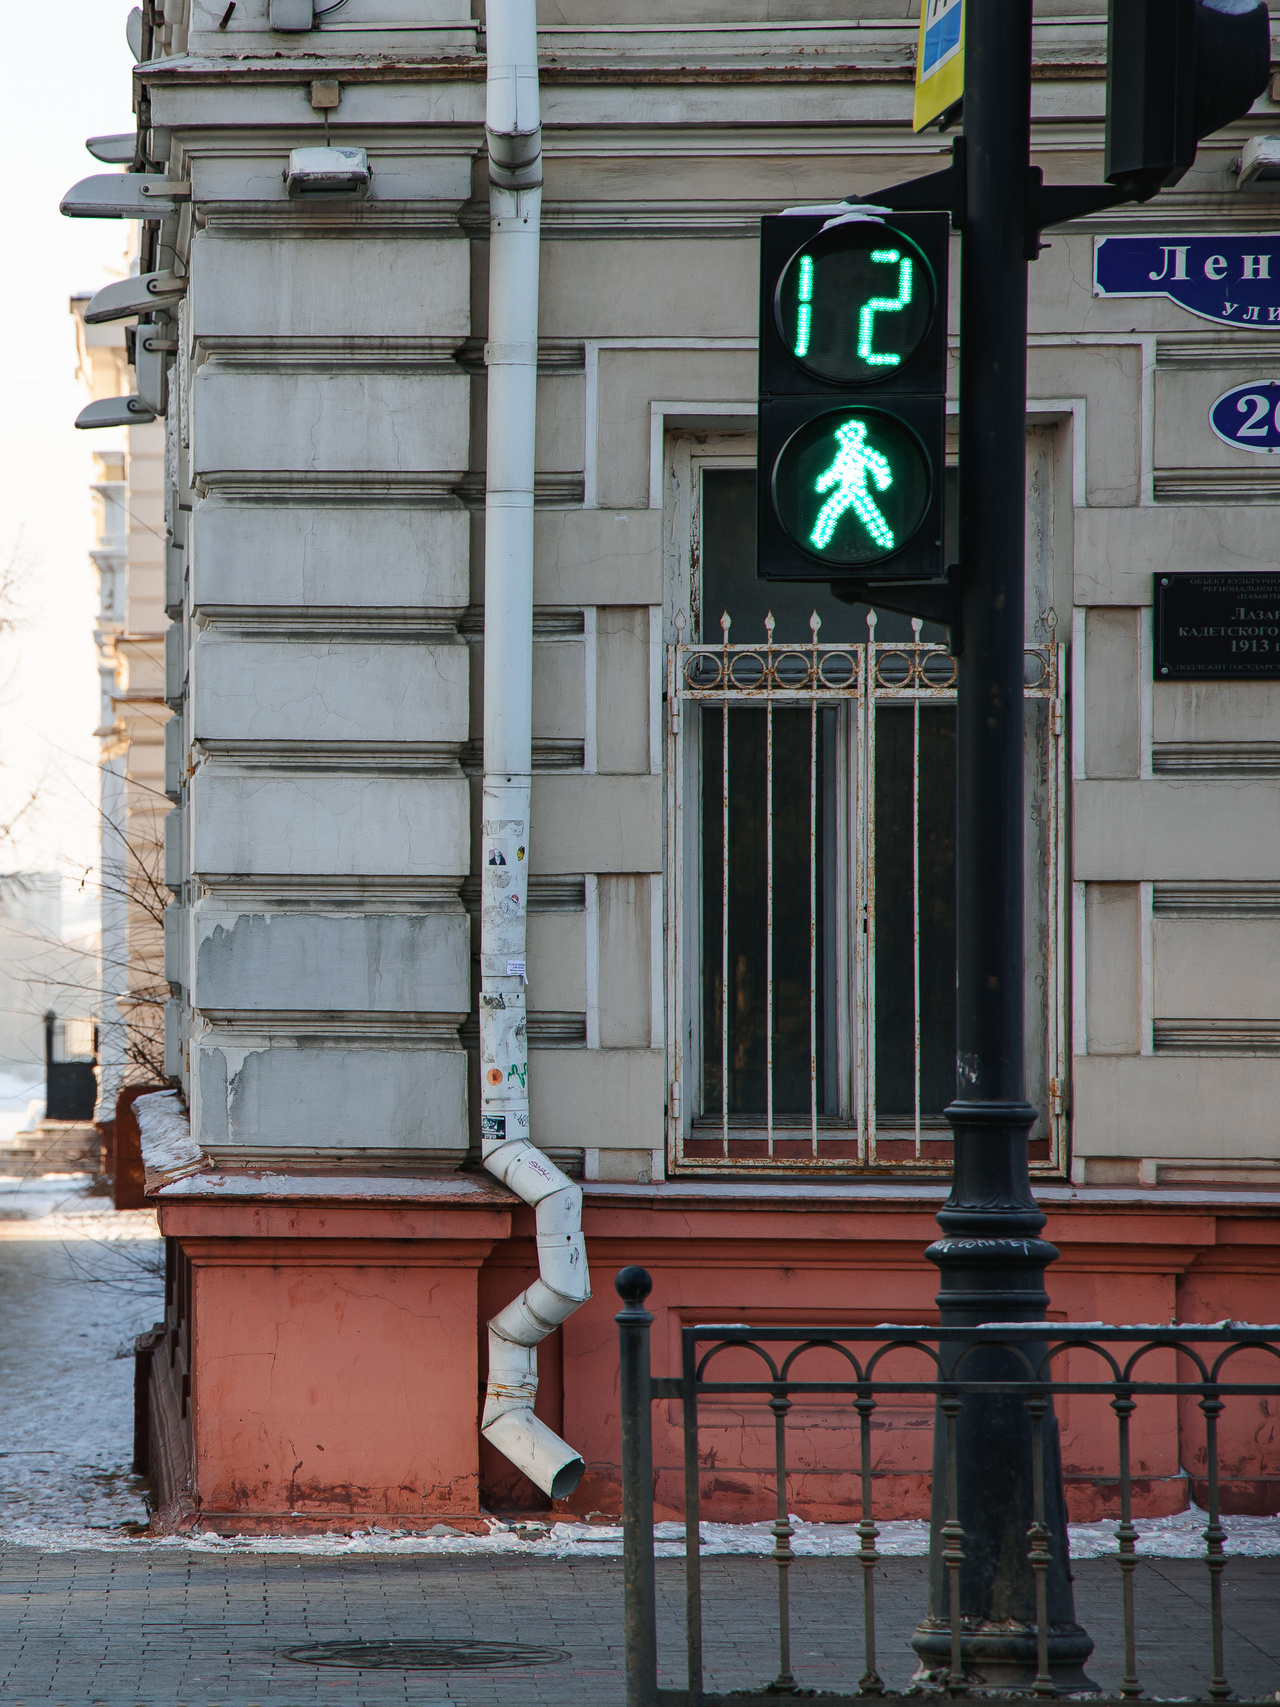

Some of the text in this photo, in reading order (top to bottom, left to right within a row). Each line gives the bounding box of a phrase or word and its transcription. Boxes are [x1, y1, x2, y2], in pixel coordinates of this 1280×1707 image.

[1148, 245, 1272, 281] Лен
[794, 249, 913, 366] 12
[1236, 394, 1280, 437] 2
[1178, 626, 1279, 637] КАДЕТСКОГО
[1230, 639, 1269, 652] 1913
